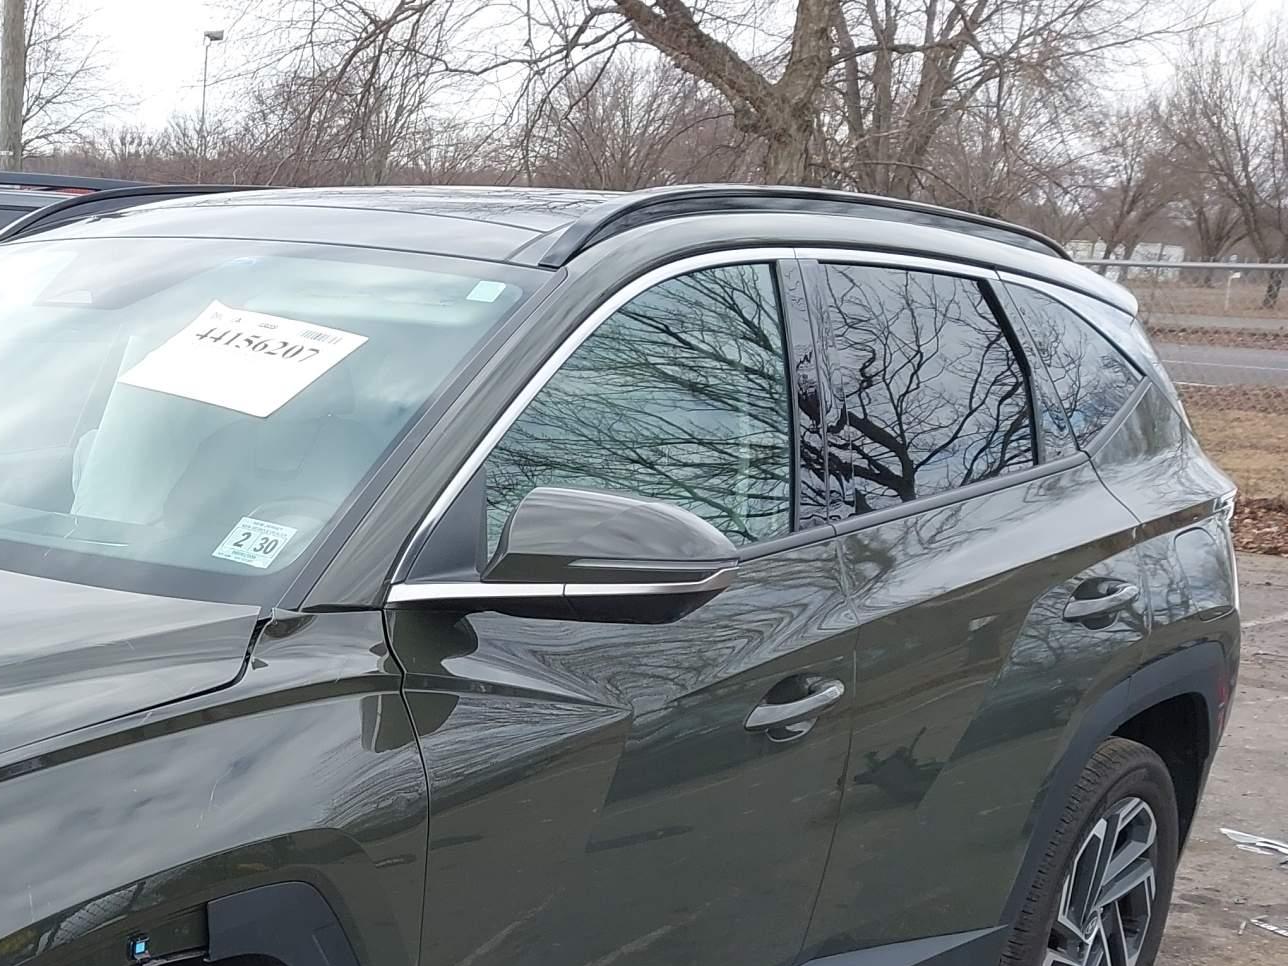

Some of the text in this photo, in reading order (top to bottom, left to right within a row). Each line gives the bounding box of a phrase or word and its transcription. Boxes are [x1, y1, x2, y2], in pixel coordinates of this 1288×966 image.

[196, 328, 320, 362] 44156207
[233, 532, 252, 548] 2
[253, 536, 279, 555] 30
